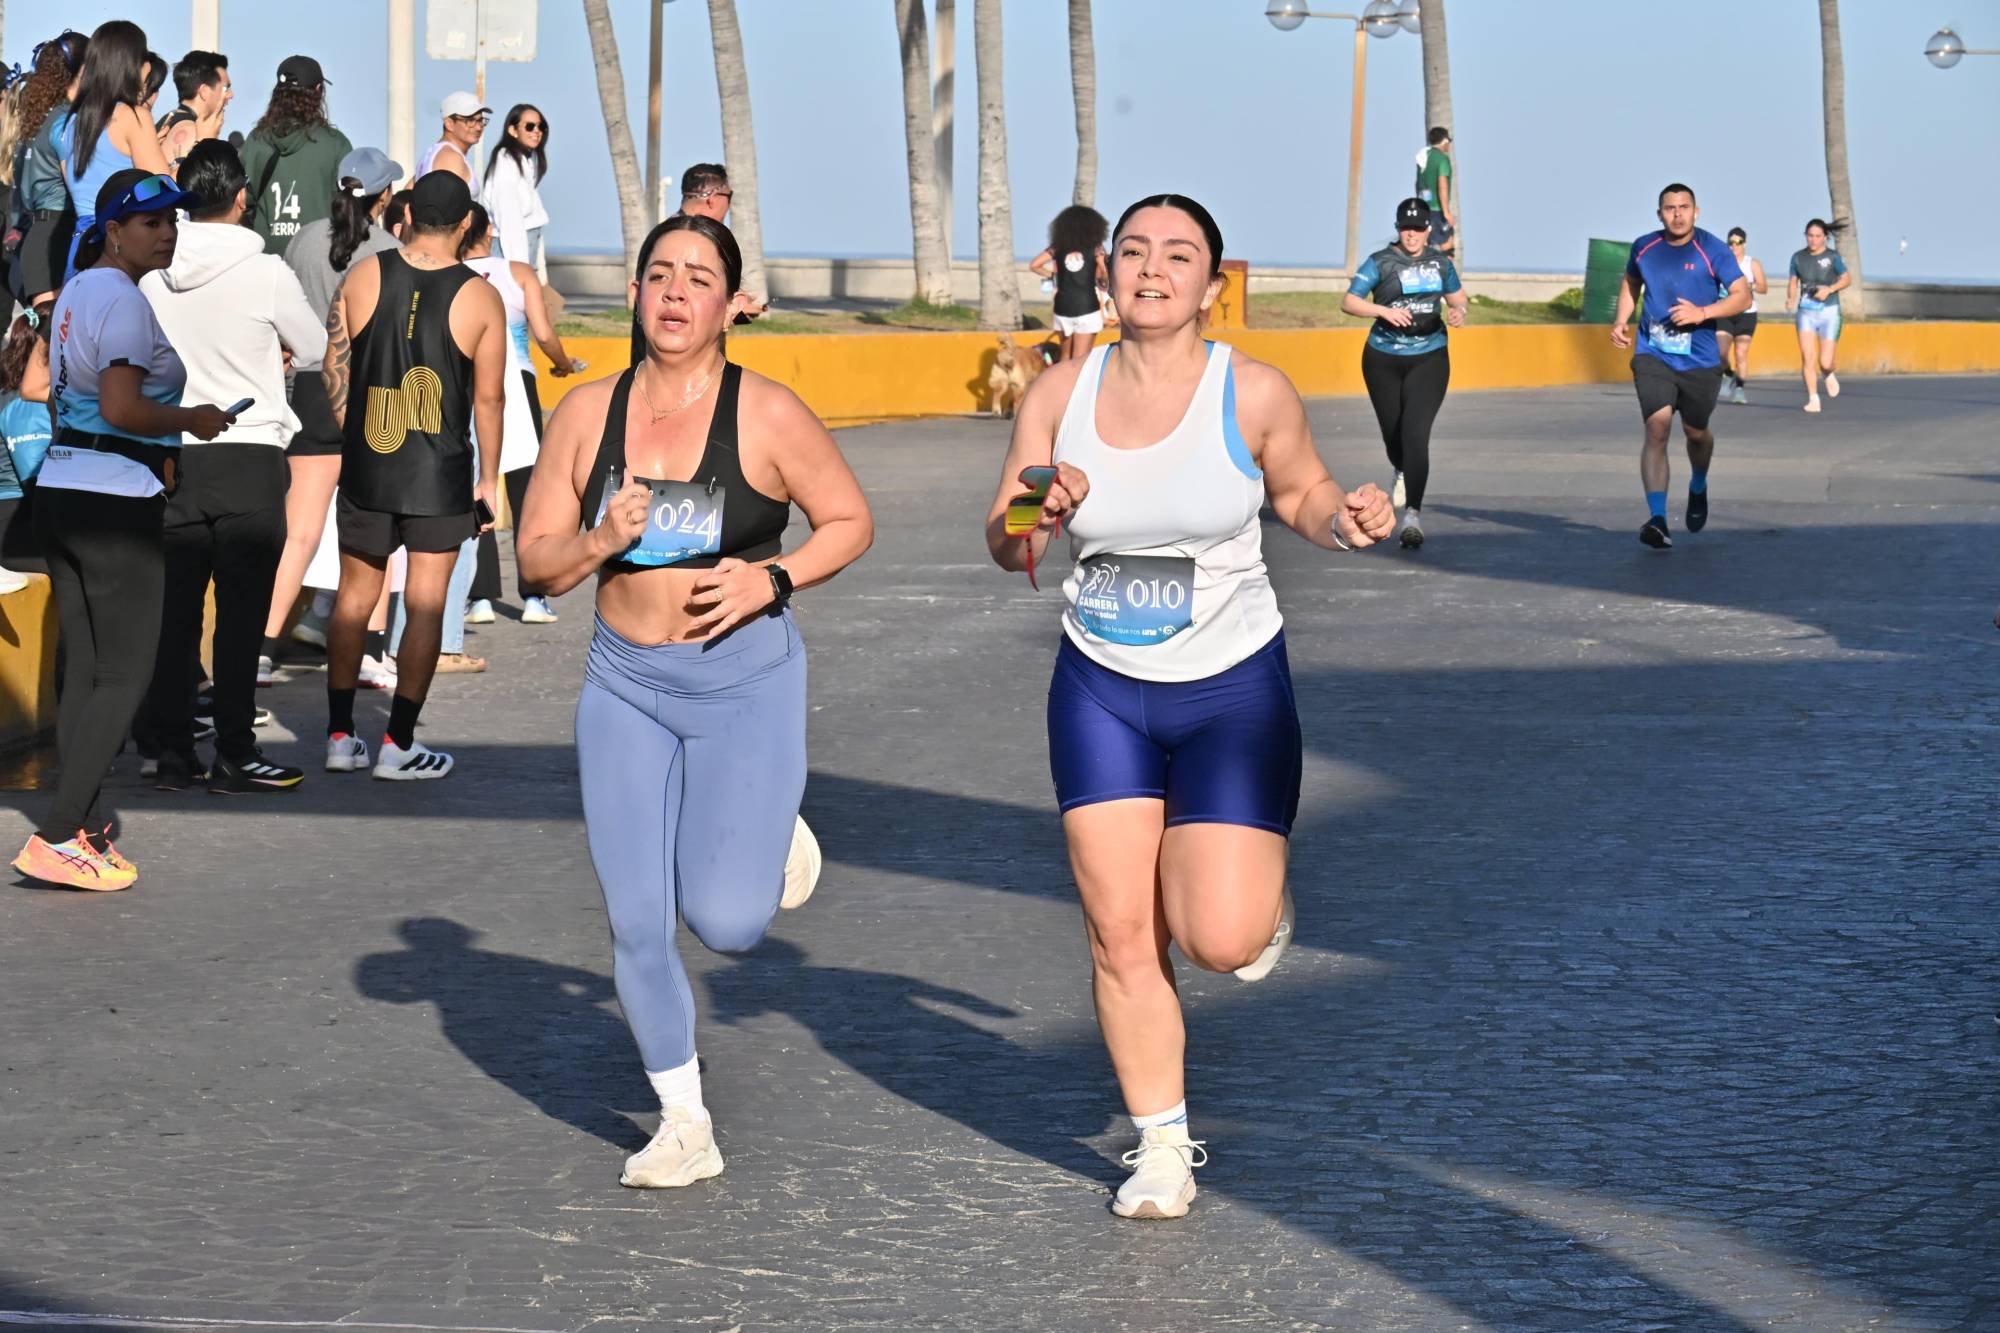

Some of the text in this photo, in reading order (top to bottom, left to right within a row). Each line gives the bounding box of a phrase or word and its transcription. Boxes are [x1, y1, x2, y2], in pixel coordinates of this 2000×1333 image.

[271, 180, 301, 221] 14
[655, 498, 719, 549] 024
[1079, 595, 1120, 612] CARRERA
[1126, 578, 1185, 609] 010
